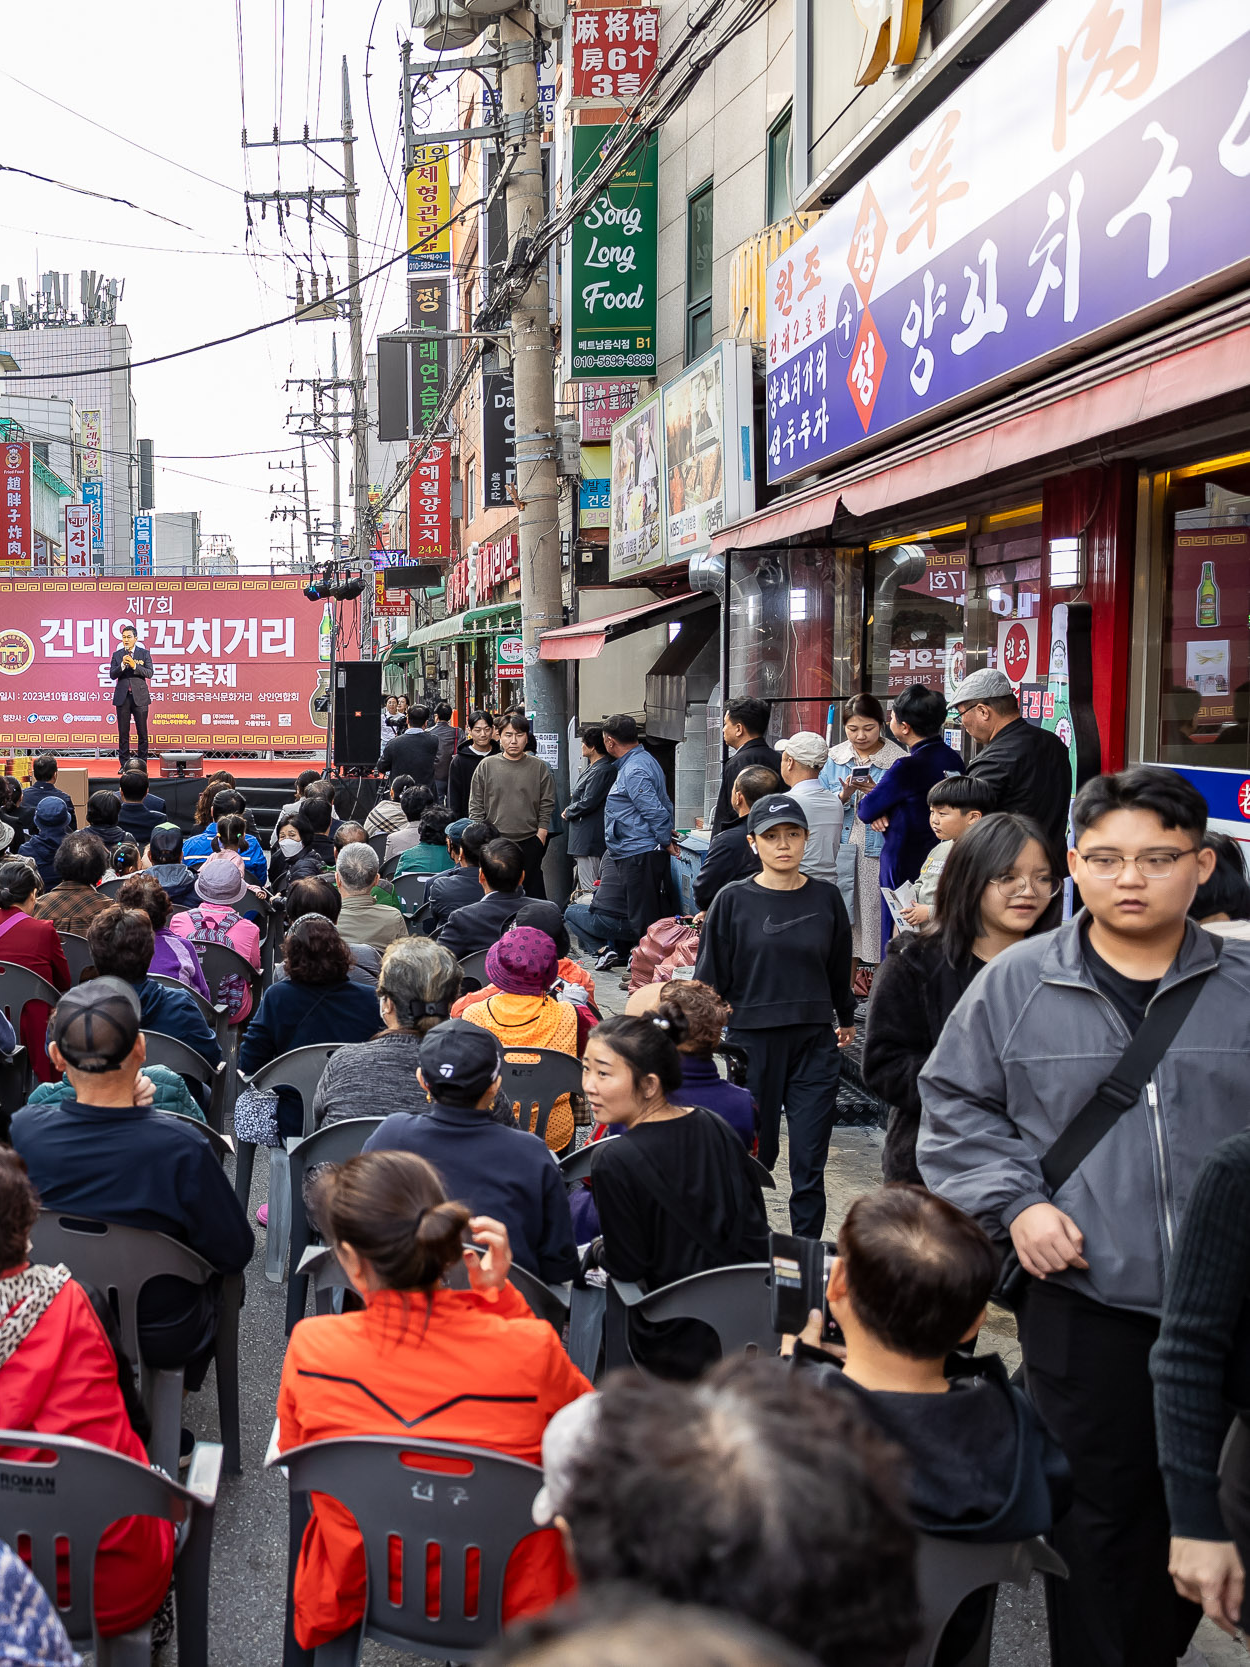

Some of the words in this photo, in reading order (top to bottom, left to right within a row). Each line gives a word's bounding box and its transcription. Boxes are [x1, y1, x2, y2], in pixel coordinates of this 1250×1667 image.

[574, 11, 658, 45] 麻将馆
[580, 44, 652, 72] 房6个
[591, 72, 641, 97] 3층
[416, 166, 442, 242] 체형관리
[584, 196, 643, 236] Song
[420, 242, 438, 252] 2F
[583, 236, 637, 274] Long
[775, 245, 822, 317] 원조
[581, 280, 645, 314] Food
[578, 339, 630, 350] 베트남음식점
[636, 337, 651, 350] B1
[573, 353, 654, 368] 010-5696-9889
[768, 396, 830, 466] 선두주자
[418, 465, 442, 544] 해월양꼬치
[417, 544, 443, 555] 24시
[125, 595, 174, 616] 제7회
[502, 642, 523, 654] 맥주
[1005, 637, 1028, 665] 원조
[498, 667, 523, 676] 해월양꼬
[0, 691, 16, 702] 일시
[171, 692, 253, 702] 건대중국음식문화거리
[257, 692, 300, 702] 상인연합회
[0, 1473, 56, 1489] ROMAN
